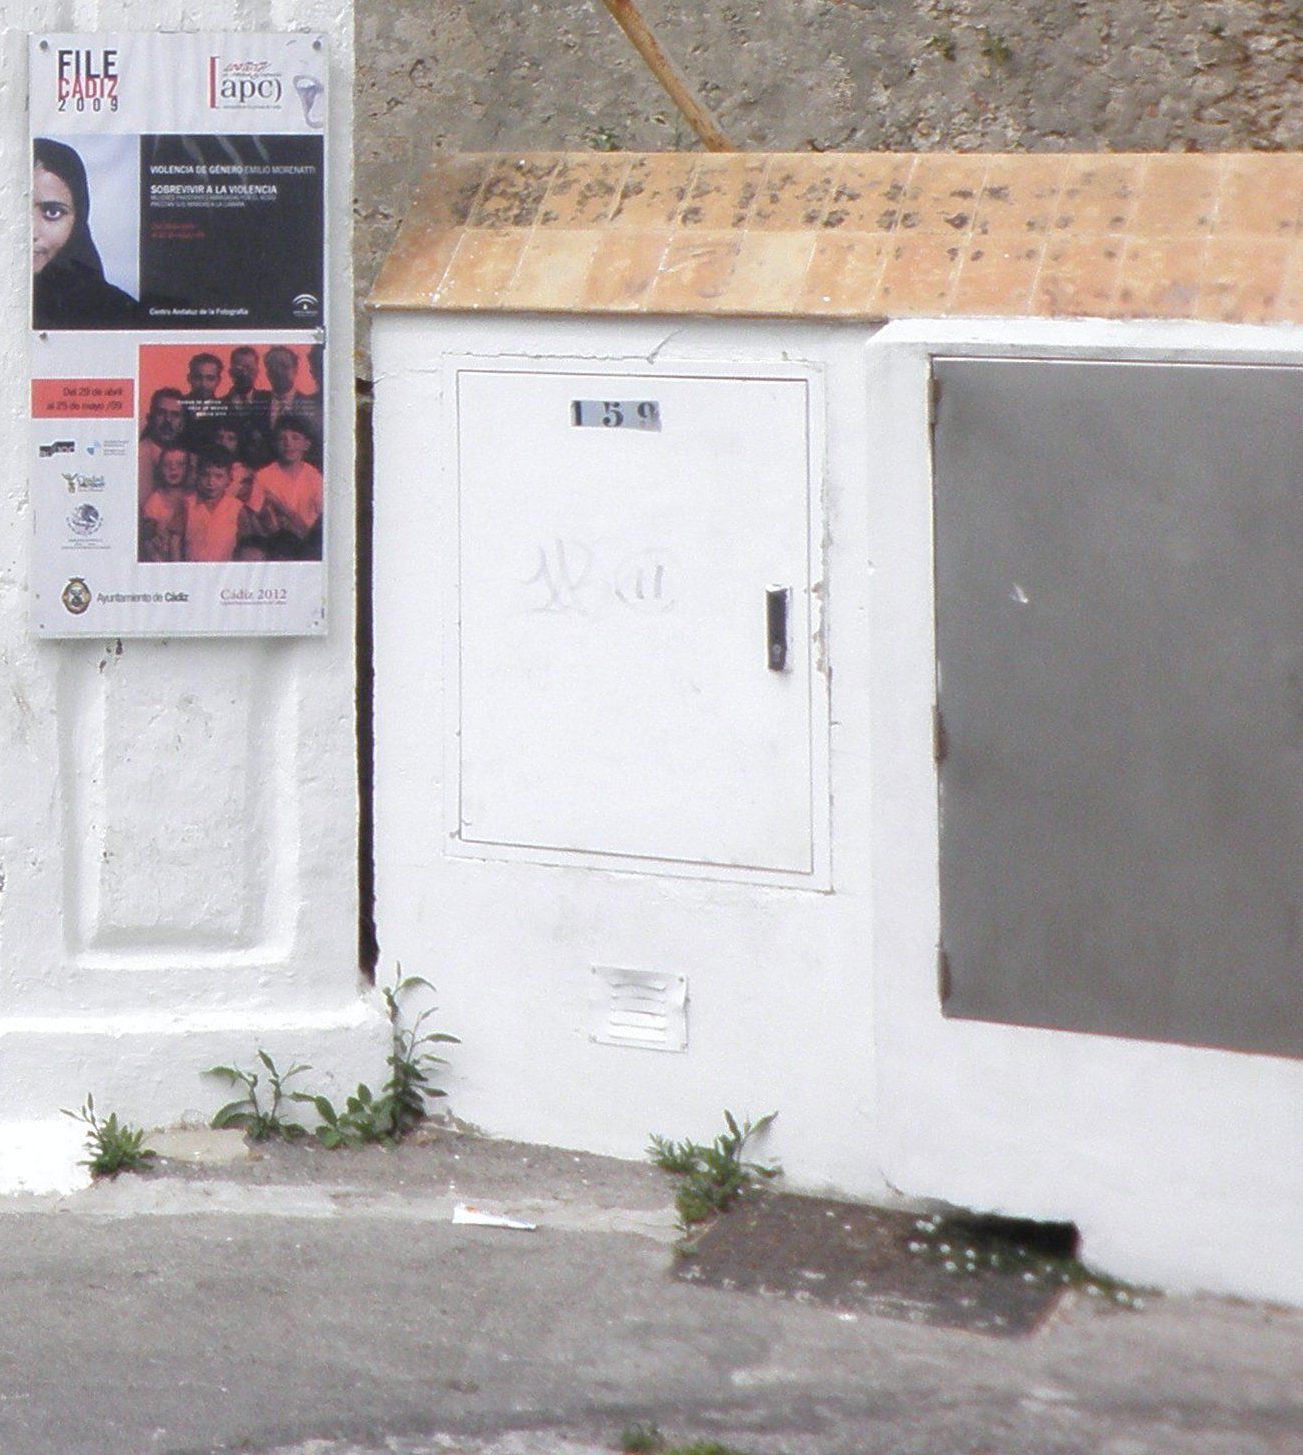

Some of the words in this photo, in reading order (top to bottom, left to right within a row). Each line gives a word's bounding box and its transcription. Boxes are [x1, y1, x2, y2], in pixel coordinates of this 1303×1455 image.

[58, 49, 118, 78] FILE
[58, 96, 118, 112] 2009
[150, 164, 194, 175] VIOLENCIA
[196, 165, 207, 175] DE
[150, 184, 204, 194] SOBREVIVIR
[206, 184, 213, 194] A
[215, 184, 227, 194] LA
[228, 184, 277, 194] VIOLENCIA
[199, 307, 207, 316] de
[97, 592, 151, 605] Ayuntamiento
[153, 592, 163, 602] de
[257, 588, 288, 600] 2012
